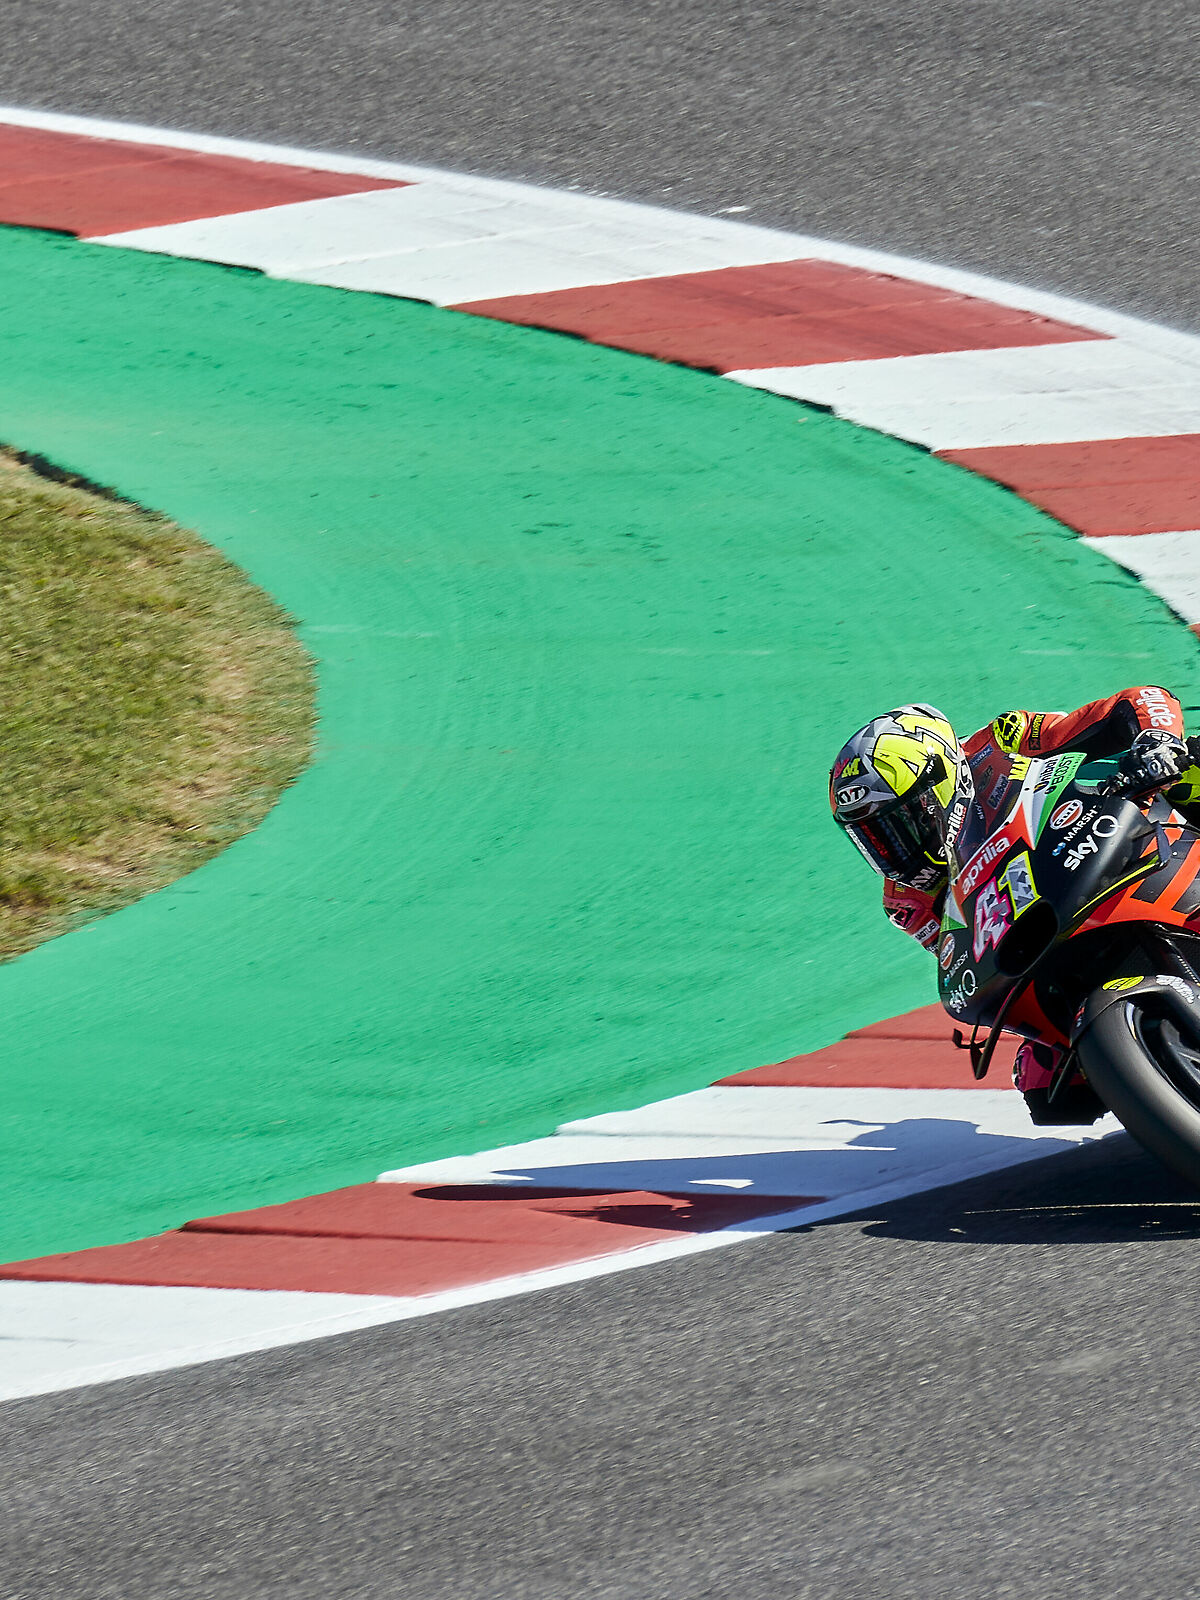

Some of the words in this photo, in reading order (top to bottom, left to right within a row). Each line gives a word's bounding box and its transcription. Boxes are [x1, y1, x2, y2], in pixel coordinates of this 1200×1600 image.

[1136, 688, 1177, 728] aprilia
[1064, 807, 1098, 842] MARSH
[961, 837, 1011, 895] aprilia
